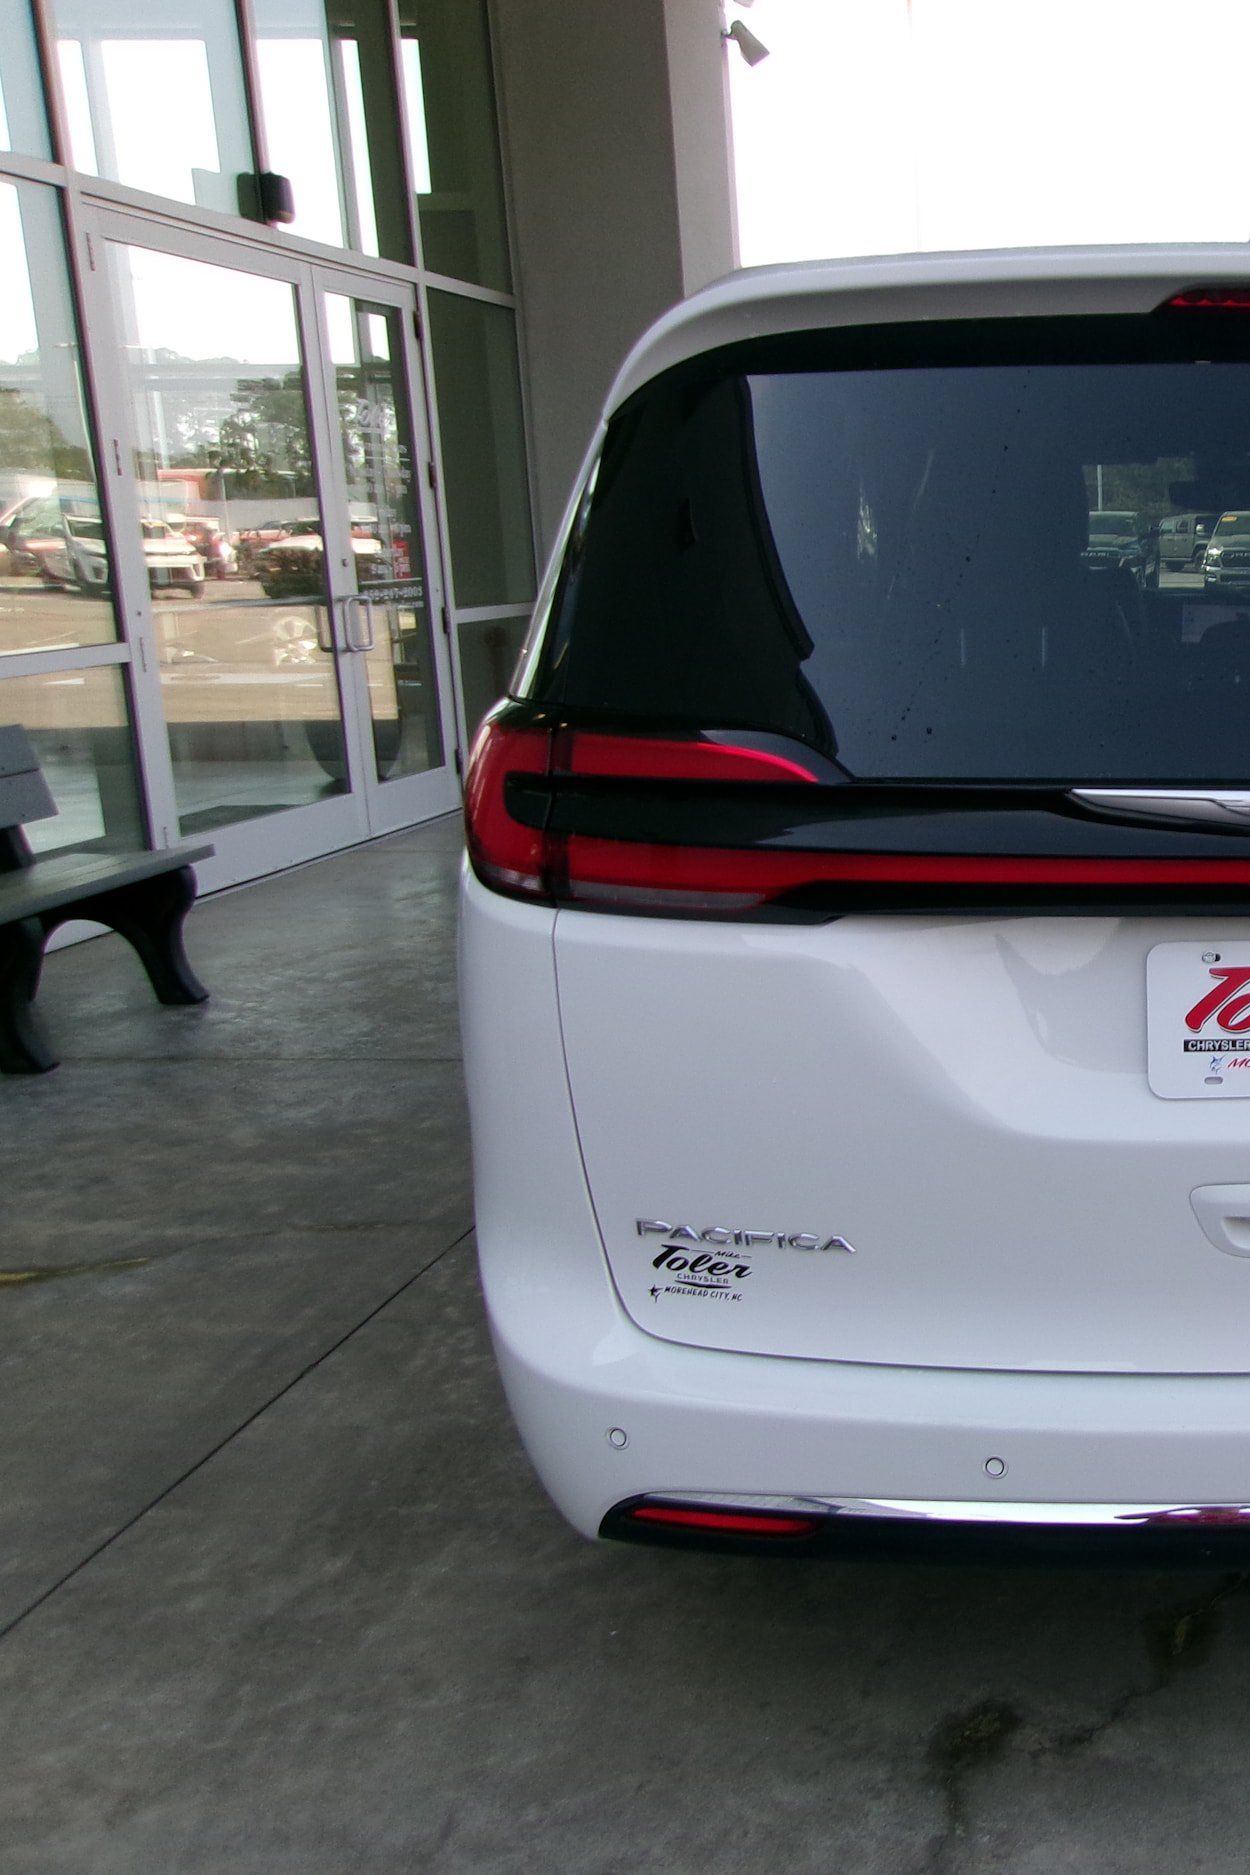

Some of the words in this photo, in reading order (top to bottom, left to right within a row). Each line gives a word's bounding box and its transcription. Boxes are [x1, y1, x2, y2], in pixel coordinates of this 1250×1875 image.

[636, 1218, 857, 1254] PACIFICA
[652, 1244, 753, 1279] Toler
[677, 1272, 729, 1284] CHRYSLER
[664, 1285, 708, 1297] MOREHEAD
[710, 1290, 730, 1301] CITY,
[731, 1292, 743, 1301] NC
